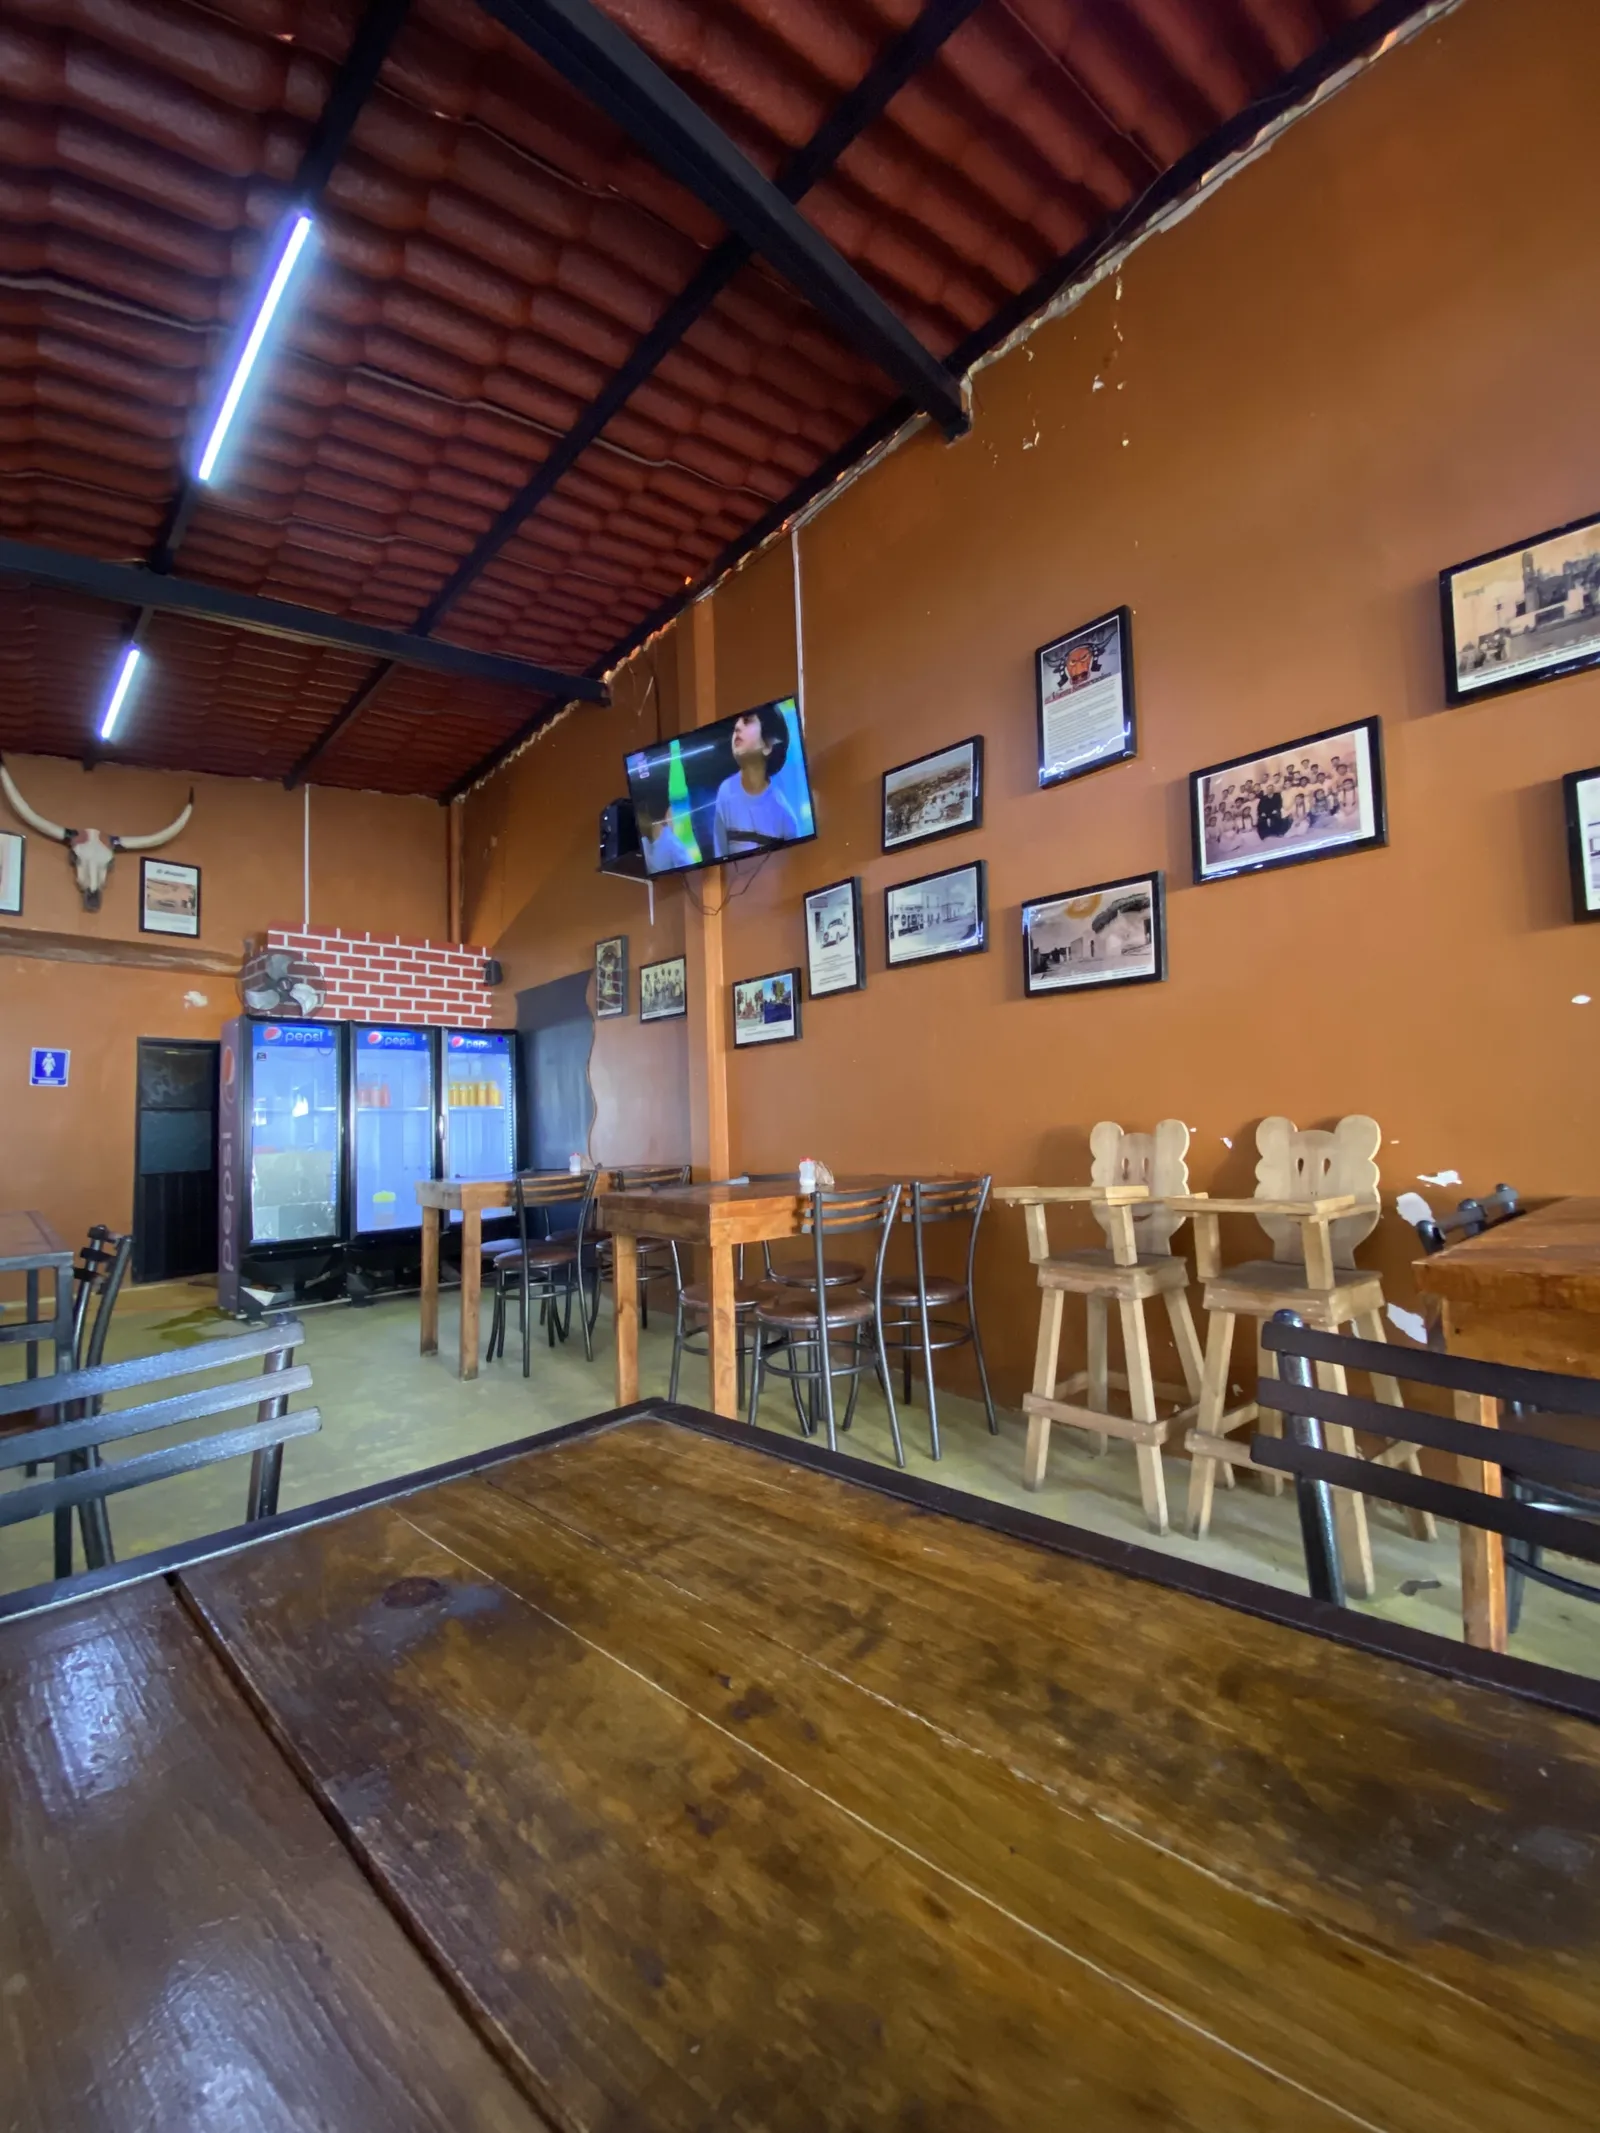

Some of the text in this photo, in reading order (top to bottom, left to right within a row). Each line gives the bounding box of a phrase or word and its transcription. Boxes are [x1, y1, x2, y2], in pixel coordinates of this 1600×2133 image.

[285, 1031, 324, 1043] pepsi
[384, 1035, 415, 1046] pepsi
[466, 1039, 492, 1049] pepsi
[222, 1132, 234, 1271] pepsi
